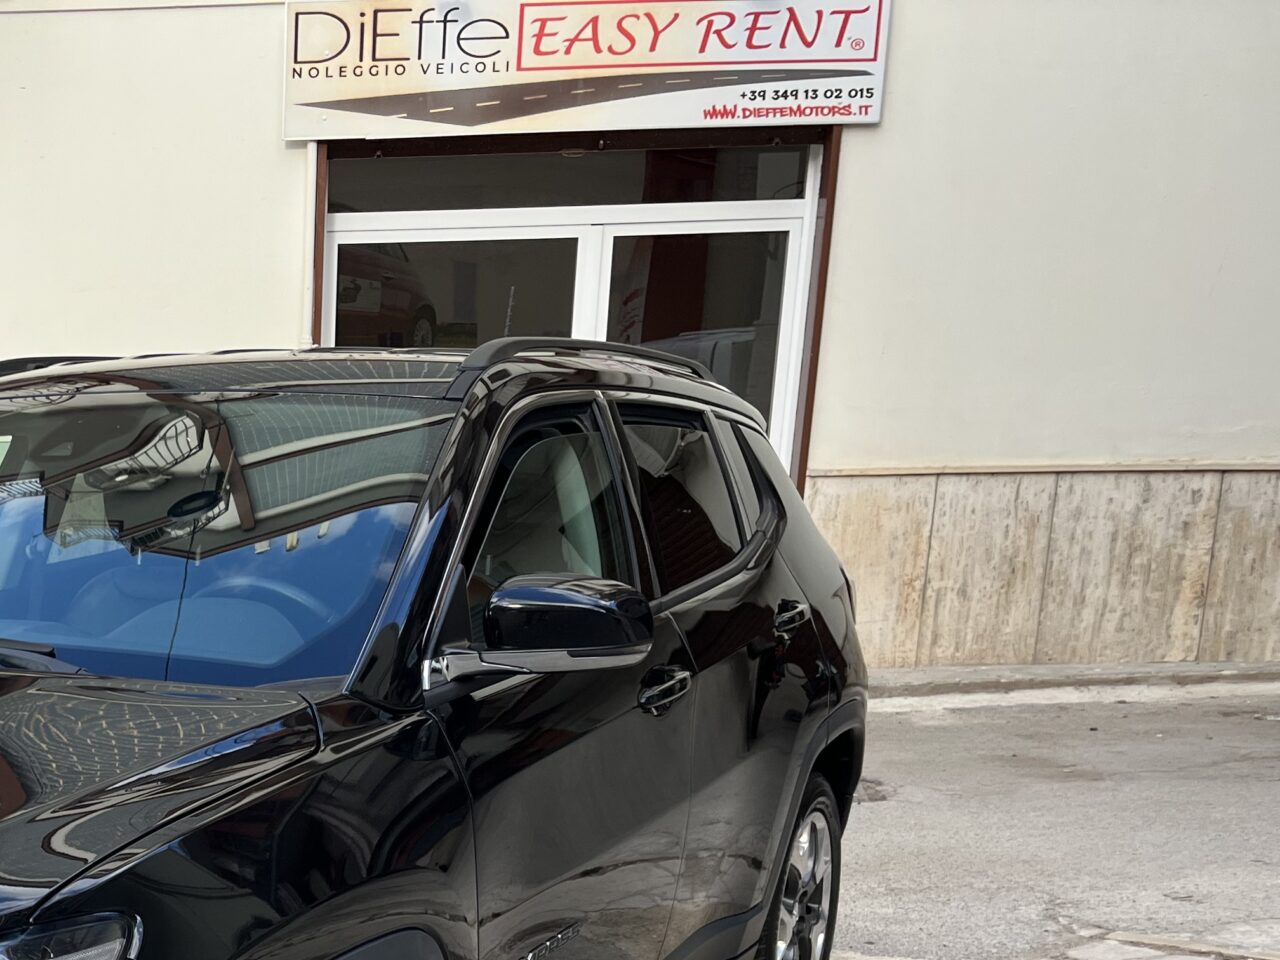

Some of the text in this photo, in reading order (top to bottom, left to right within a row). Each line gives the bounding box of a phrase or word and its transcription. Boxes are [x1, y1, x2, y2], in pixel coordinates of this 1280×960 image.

[293, 7, 510, 65] DiEffe
[530, 12, 680, 56] EASY
[292, 60, 510, 79] NOLEGGIO VEICOLI
[740, 87, 874, 101] +39 349 13 02 015
